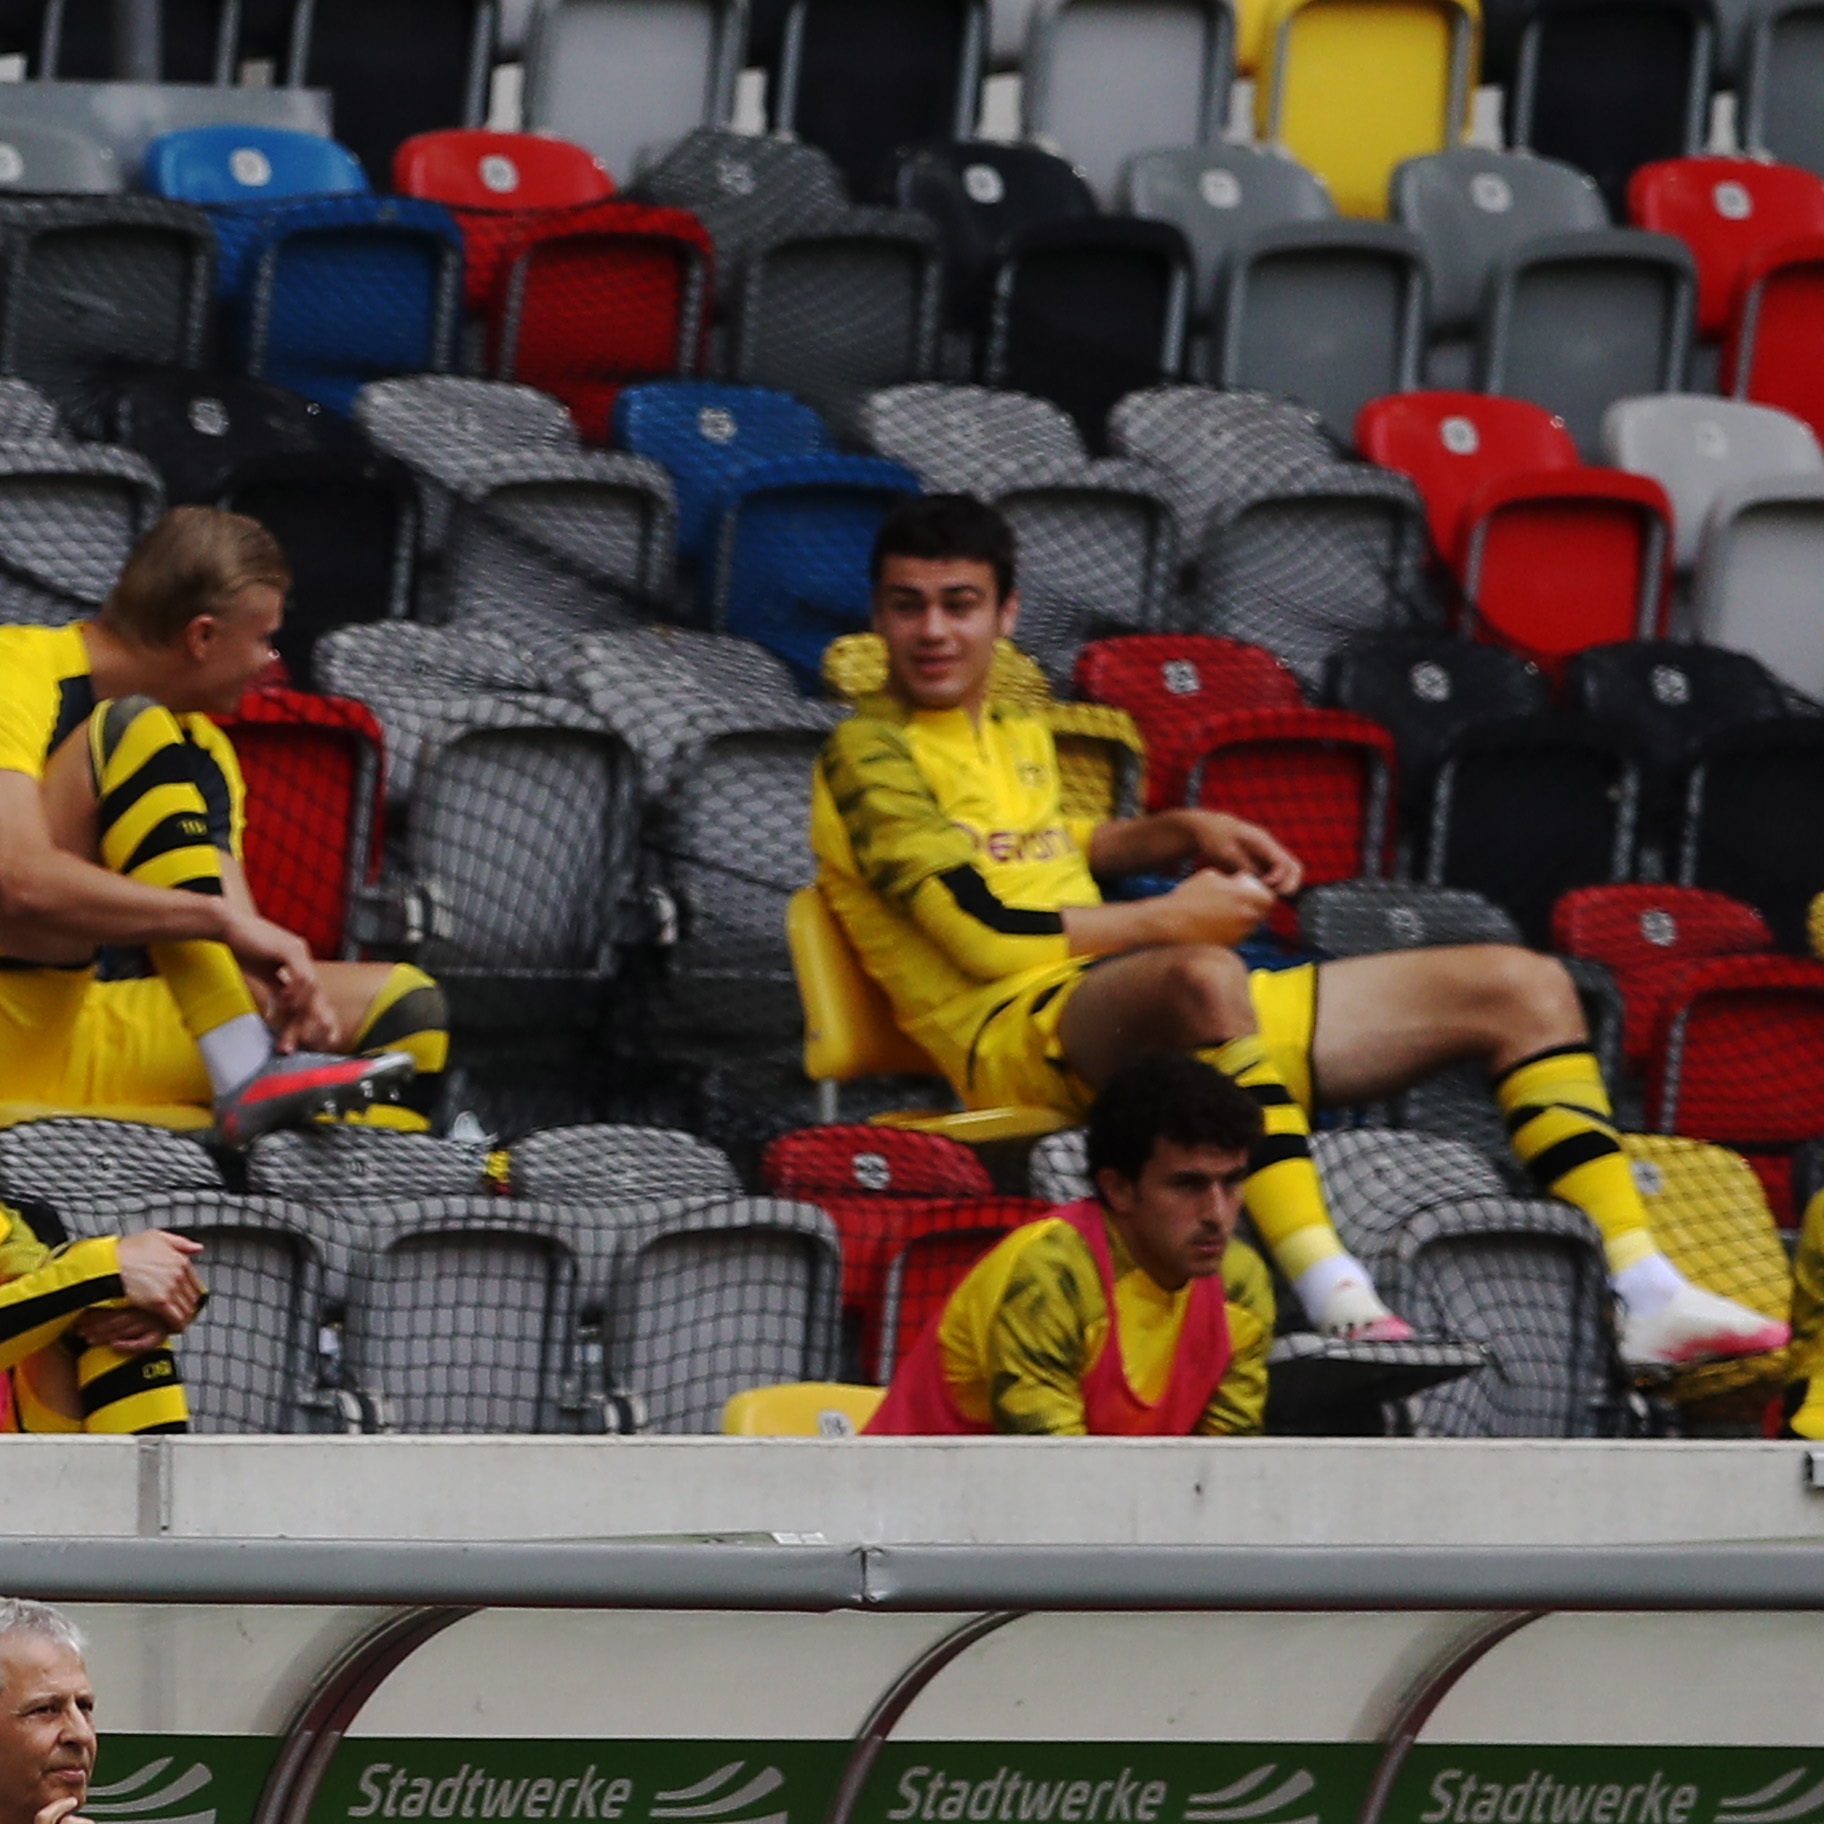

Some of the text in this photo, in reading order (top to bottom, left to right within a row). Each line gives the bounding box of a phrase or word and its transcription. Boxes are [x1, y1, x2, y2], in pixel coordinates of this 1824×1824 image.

[347, 1762, 634, 1819] Stadtwerke
[886, 1765, 1169, 1822] Stadtwerke
[1420, 1767, 1700, 1824] Stadtwerke
